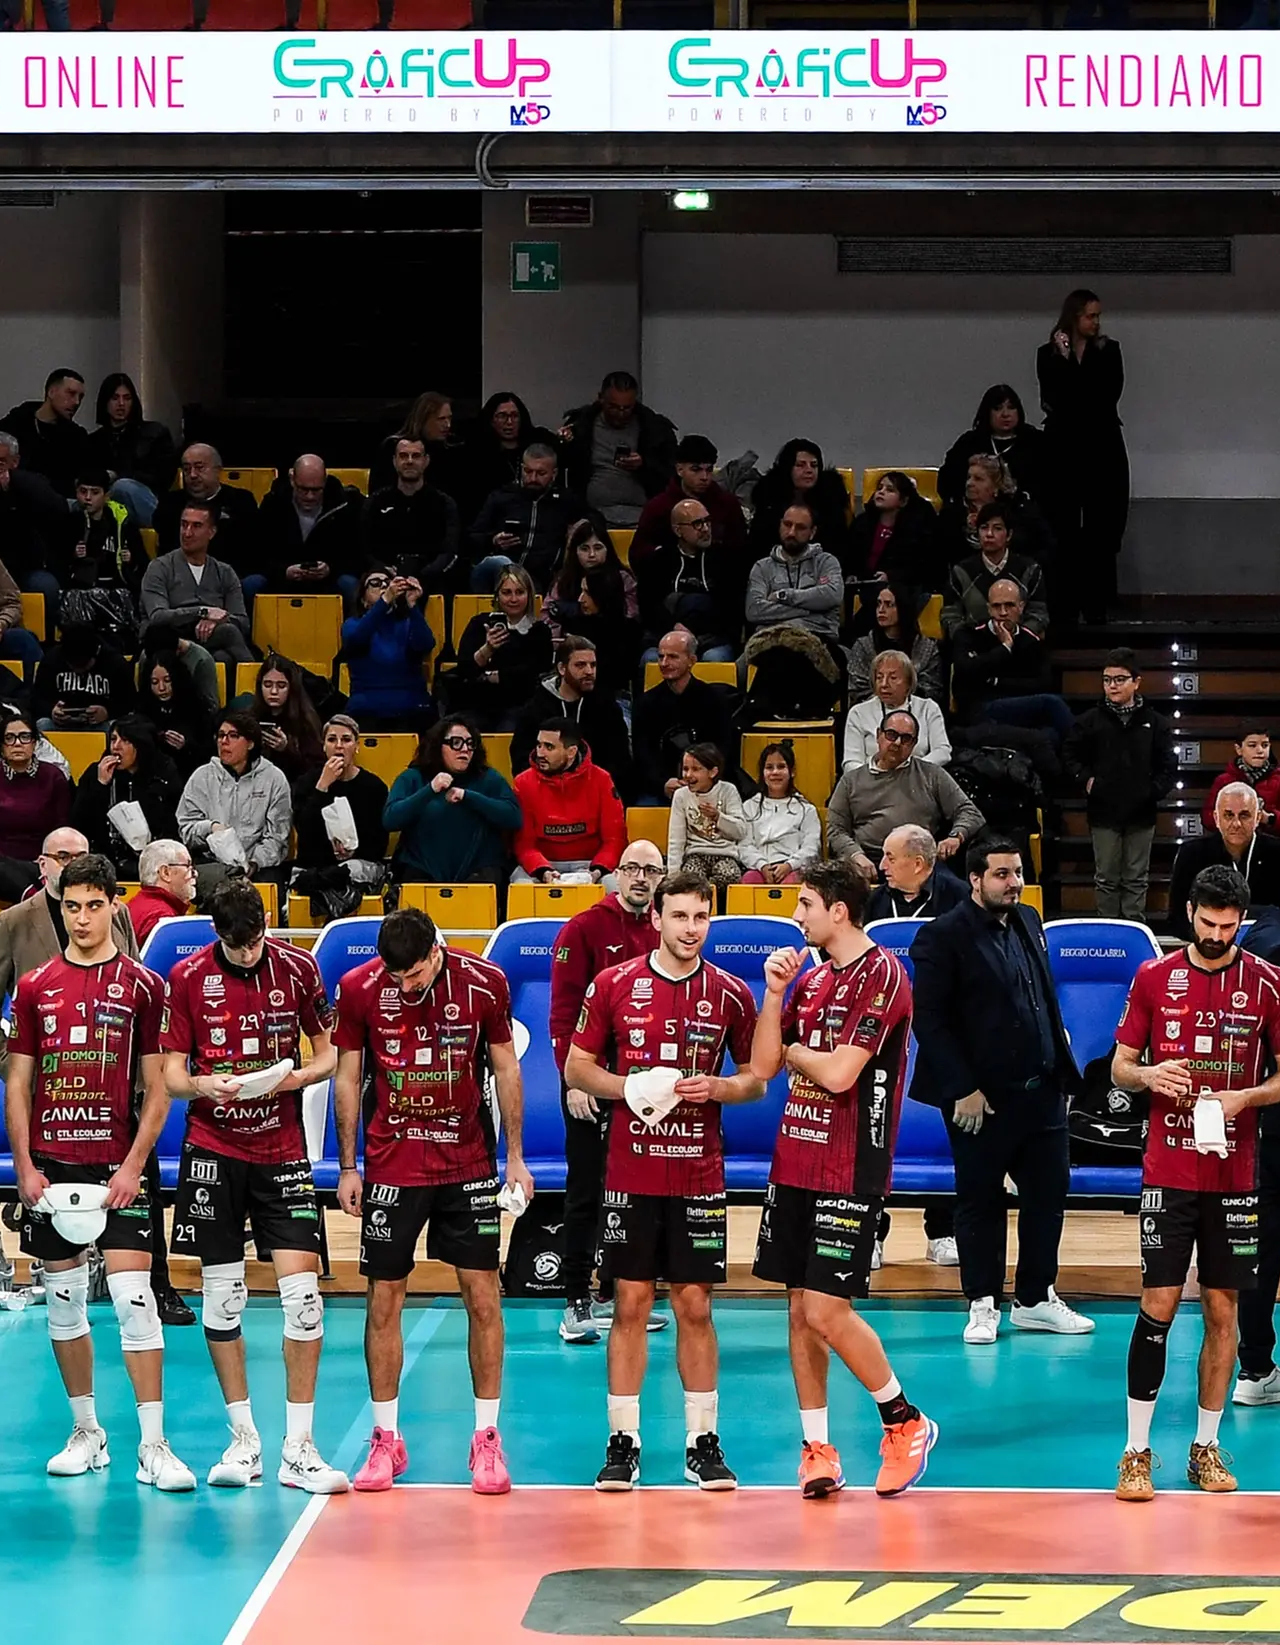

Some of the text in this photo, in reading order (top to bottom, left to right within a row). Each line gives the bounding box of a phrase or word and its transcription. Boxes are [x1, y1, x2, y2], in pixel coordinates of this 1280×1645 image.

[24, 56, 184, 109] ONLINE
[1026, 54, 1262, 107] RENDIAMO
[273, 109, 480, 122] POWERED BY
[668, 109, 876, 122] POWERED BY
[347, 945, 377, 955] REGGIO
[520, 945, 547, 956] REGGIO
[714, 944, 741, 954] REGGIO
[1060, 947, 1127, 958] REGGIO CALABRIA
[76, 1002, 86, 1018] 9
[239, 1014, 260, 1031] 29
[1195, 1011, 1216, 1028] 23
[414, 1026, 432, 1041] 12
[664, 1019, 677, 1035] 5
[62, 1051, 119, 1062] DOMOTEK
[1188, 1060, 1245, 1072] DOMOTEK
[42, 1107, 112, 1123] CANALE
[784, 1102, 832, 1124] CANALE
[57, 1129, 112, 1138] CTL ECOLOGY
[649, 1144, 704, 1154] CTL ECOLOGY
[189, 1203, 215, 1217] OASI
[24, 1224, 32, 1241] 9
[176, 1224, 195, 1242] 29
[365, 1225, 392, 1238] OASI
[604, 1228, 626, 1240] OASI
